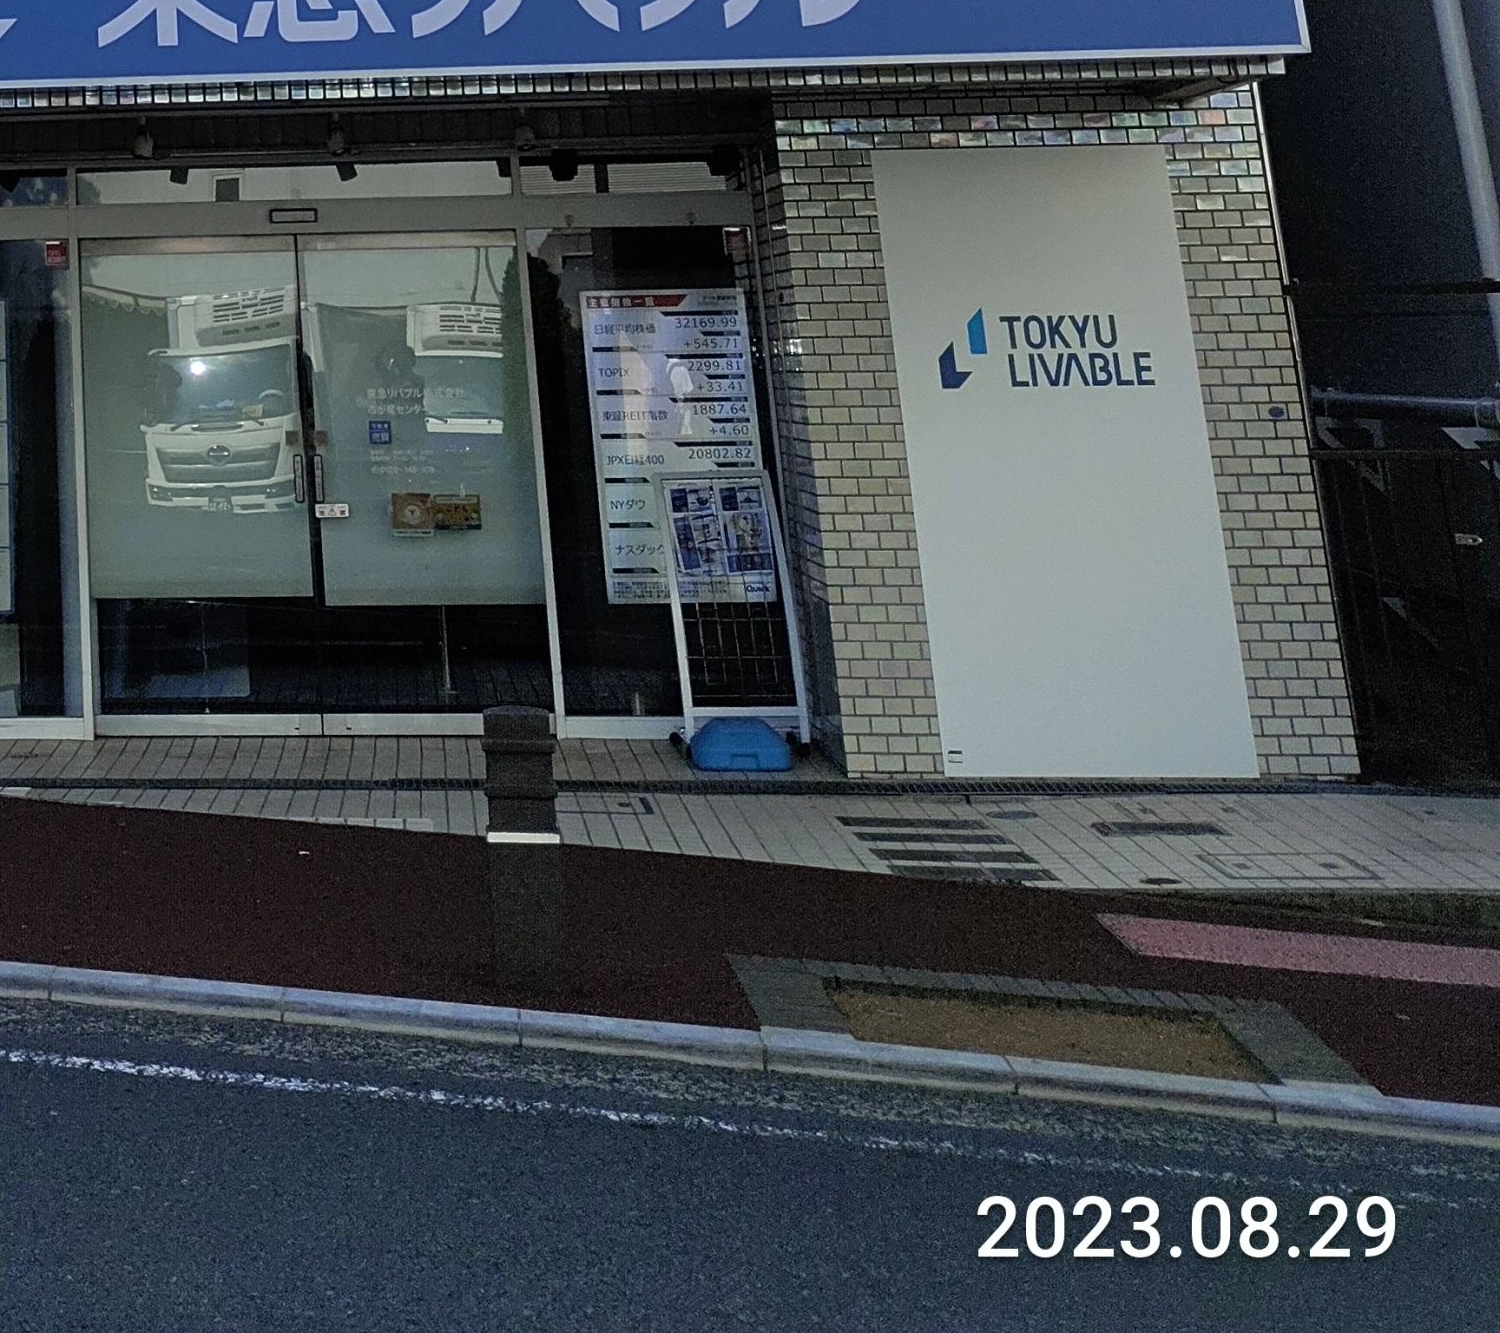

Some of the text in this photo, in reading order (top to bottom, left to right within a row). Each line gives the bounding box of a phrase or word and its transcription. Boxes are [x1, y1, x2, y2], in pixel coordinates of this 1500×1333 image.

[593, 316, 738, 335] 日経平均株価 32169.99
[1000, 313, 1118, 350] TOKYU
[683, 337, 739, 350] +545.71
[598, 359, 743, 378] TOPIX 2299.81
[1010, 350, 1157, 389] LIVABLE
[697, 381, 744, 393] +33.41
[601, 403, 747, 422] 東証REIT指数 1887.64
[708, 424, 750, 436] +4.60
[606, 447, 752, 466] JPX日経400 20802.82
[609, 498, 646, 511] NYダウ
